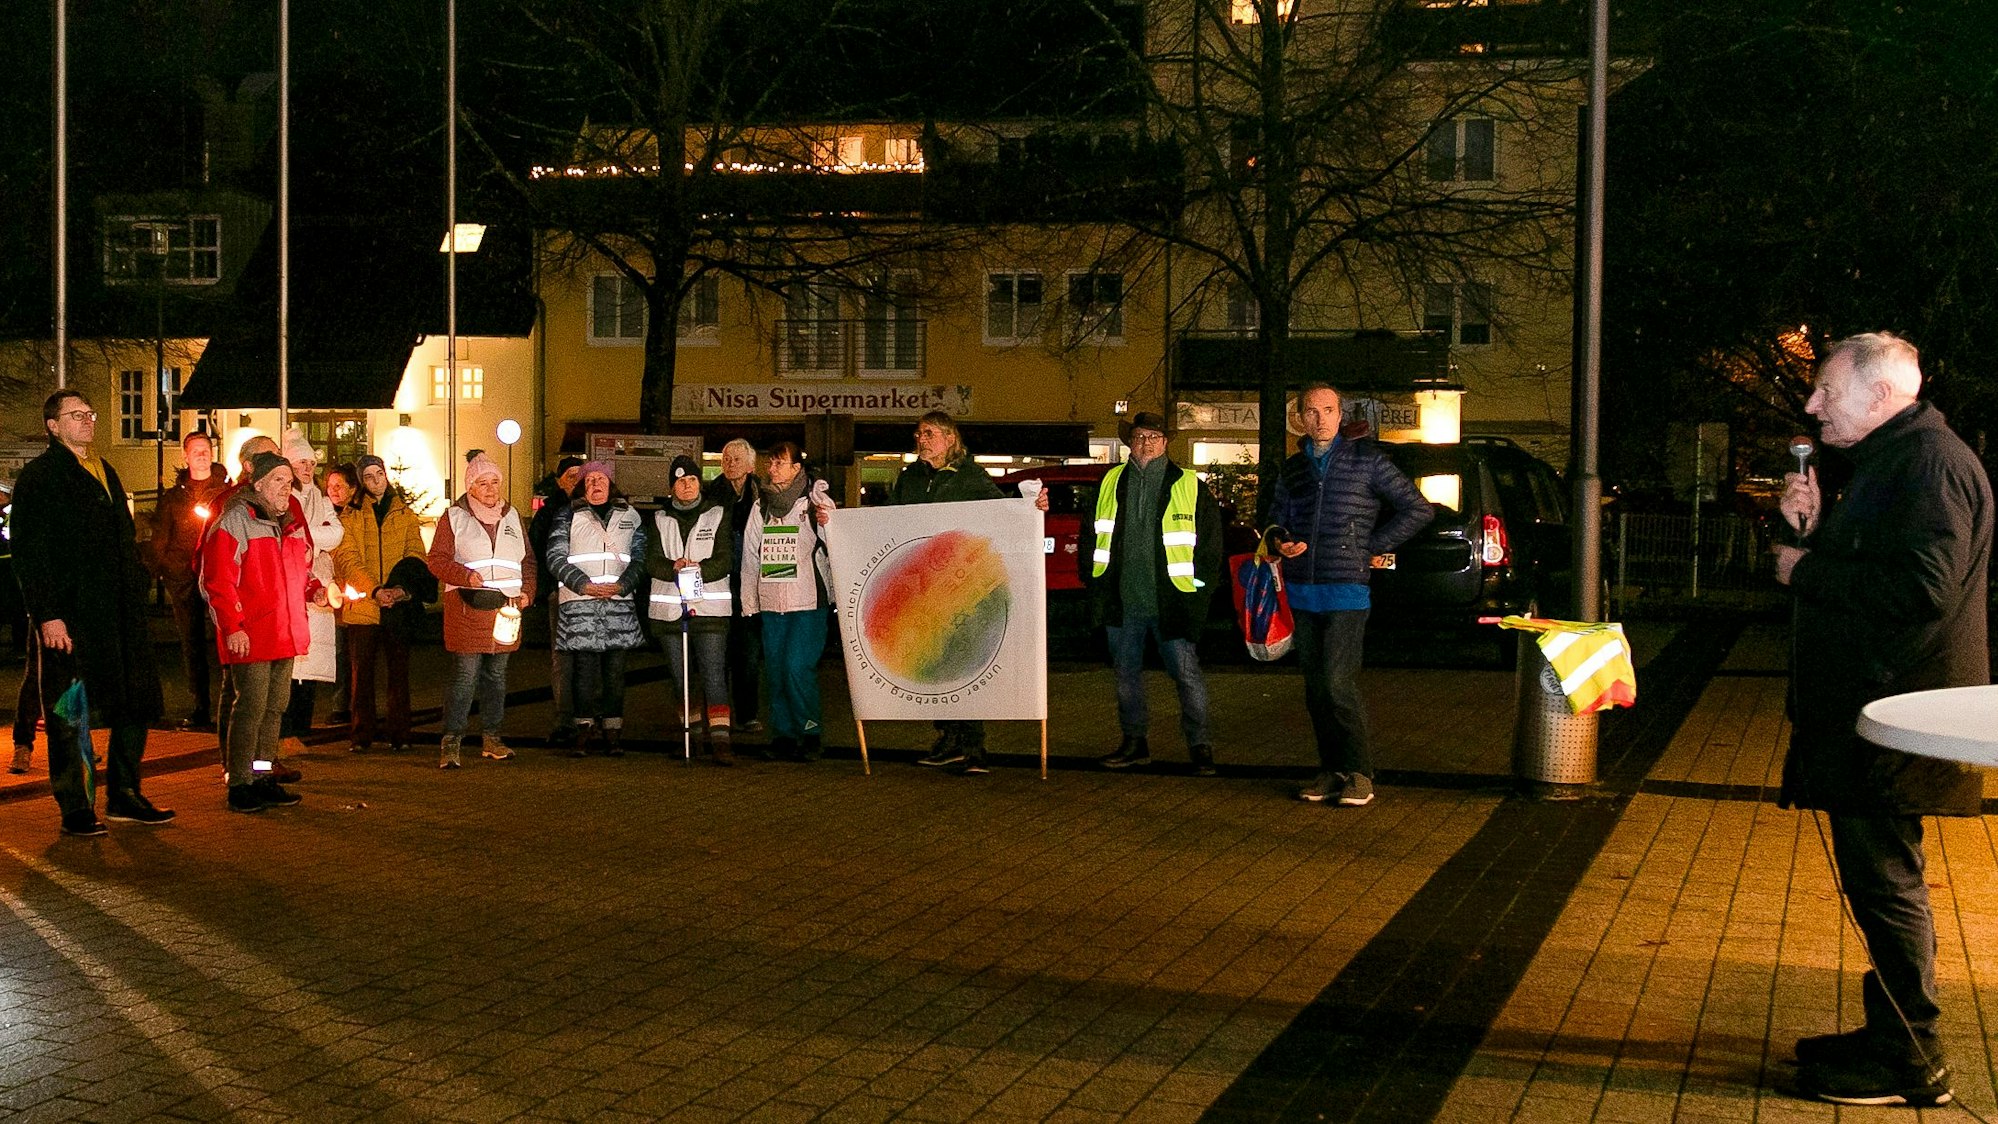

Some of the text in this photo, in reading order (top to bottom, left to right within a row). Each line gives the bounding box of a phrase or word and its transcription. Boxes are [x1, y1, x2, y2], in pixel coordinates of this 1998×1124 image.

[706, 387, 930, 413] Nisa Süpermarket
[763, 537, 797, 545] MILITÄR
[859, 537, 897, 577] braun!
[846, 582, 862, 618] nicht
[849, 638, 868, 671] bunt
[869, 672, 886, 690] ist
[967, 663, 1002, 696] Unser
[890, 686, 960, 705] Oberberg
